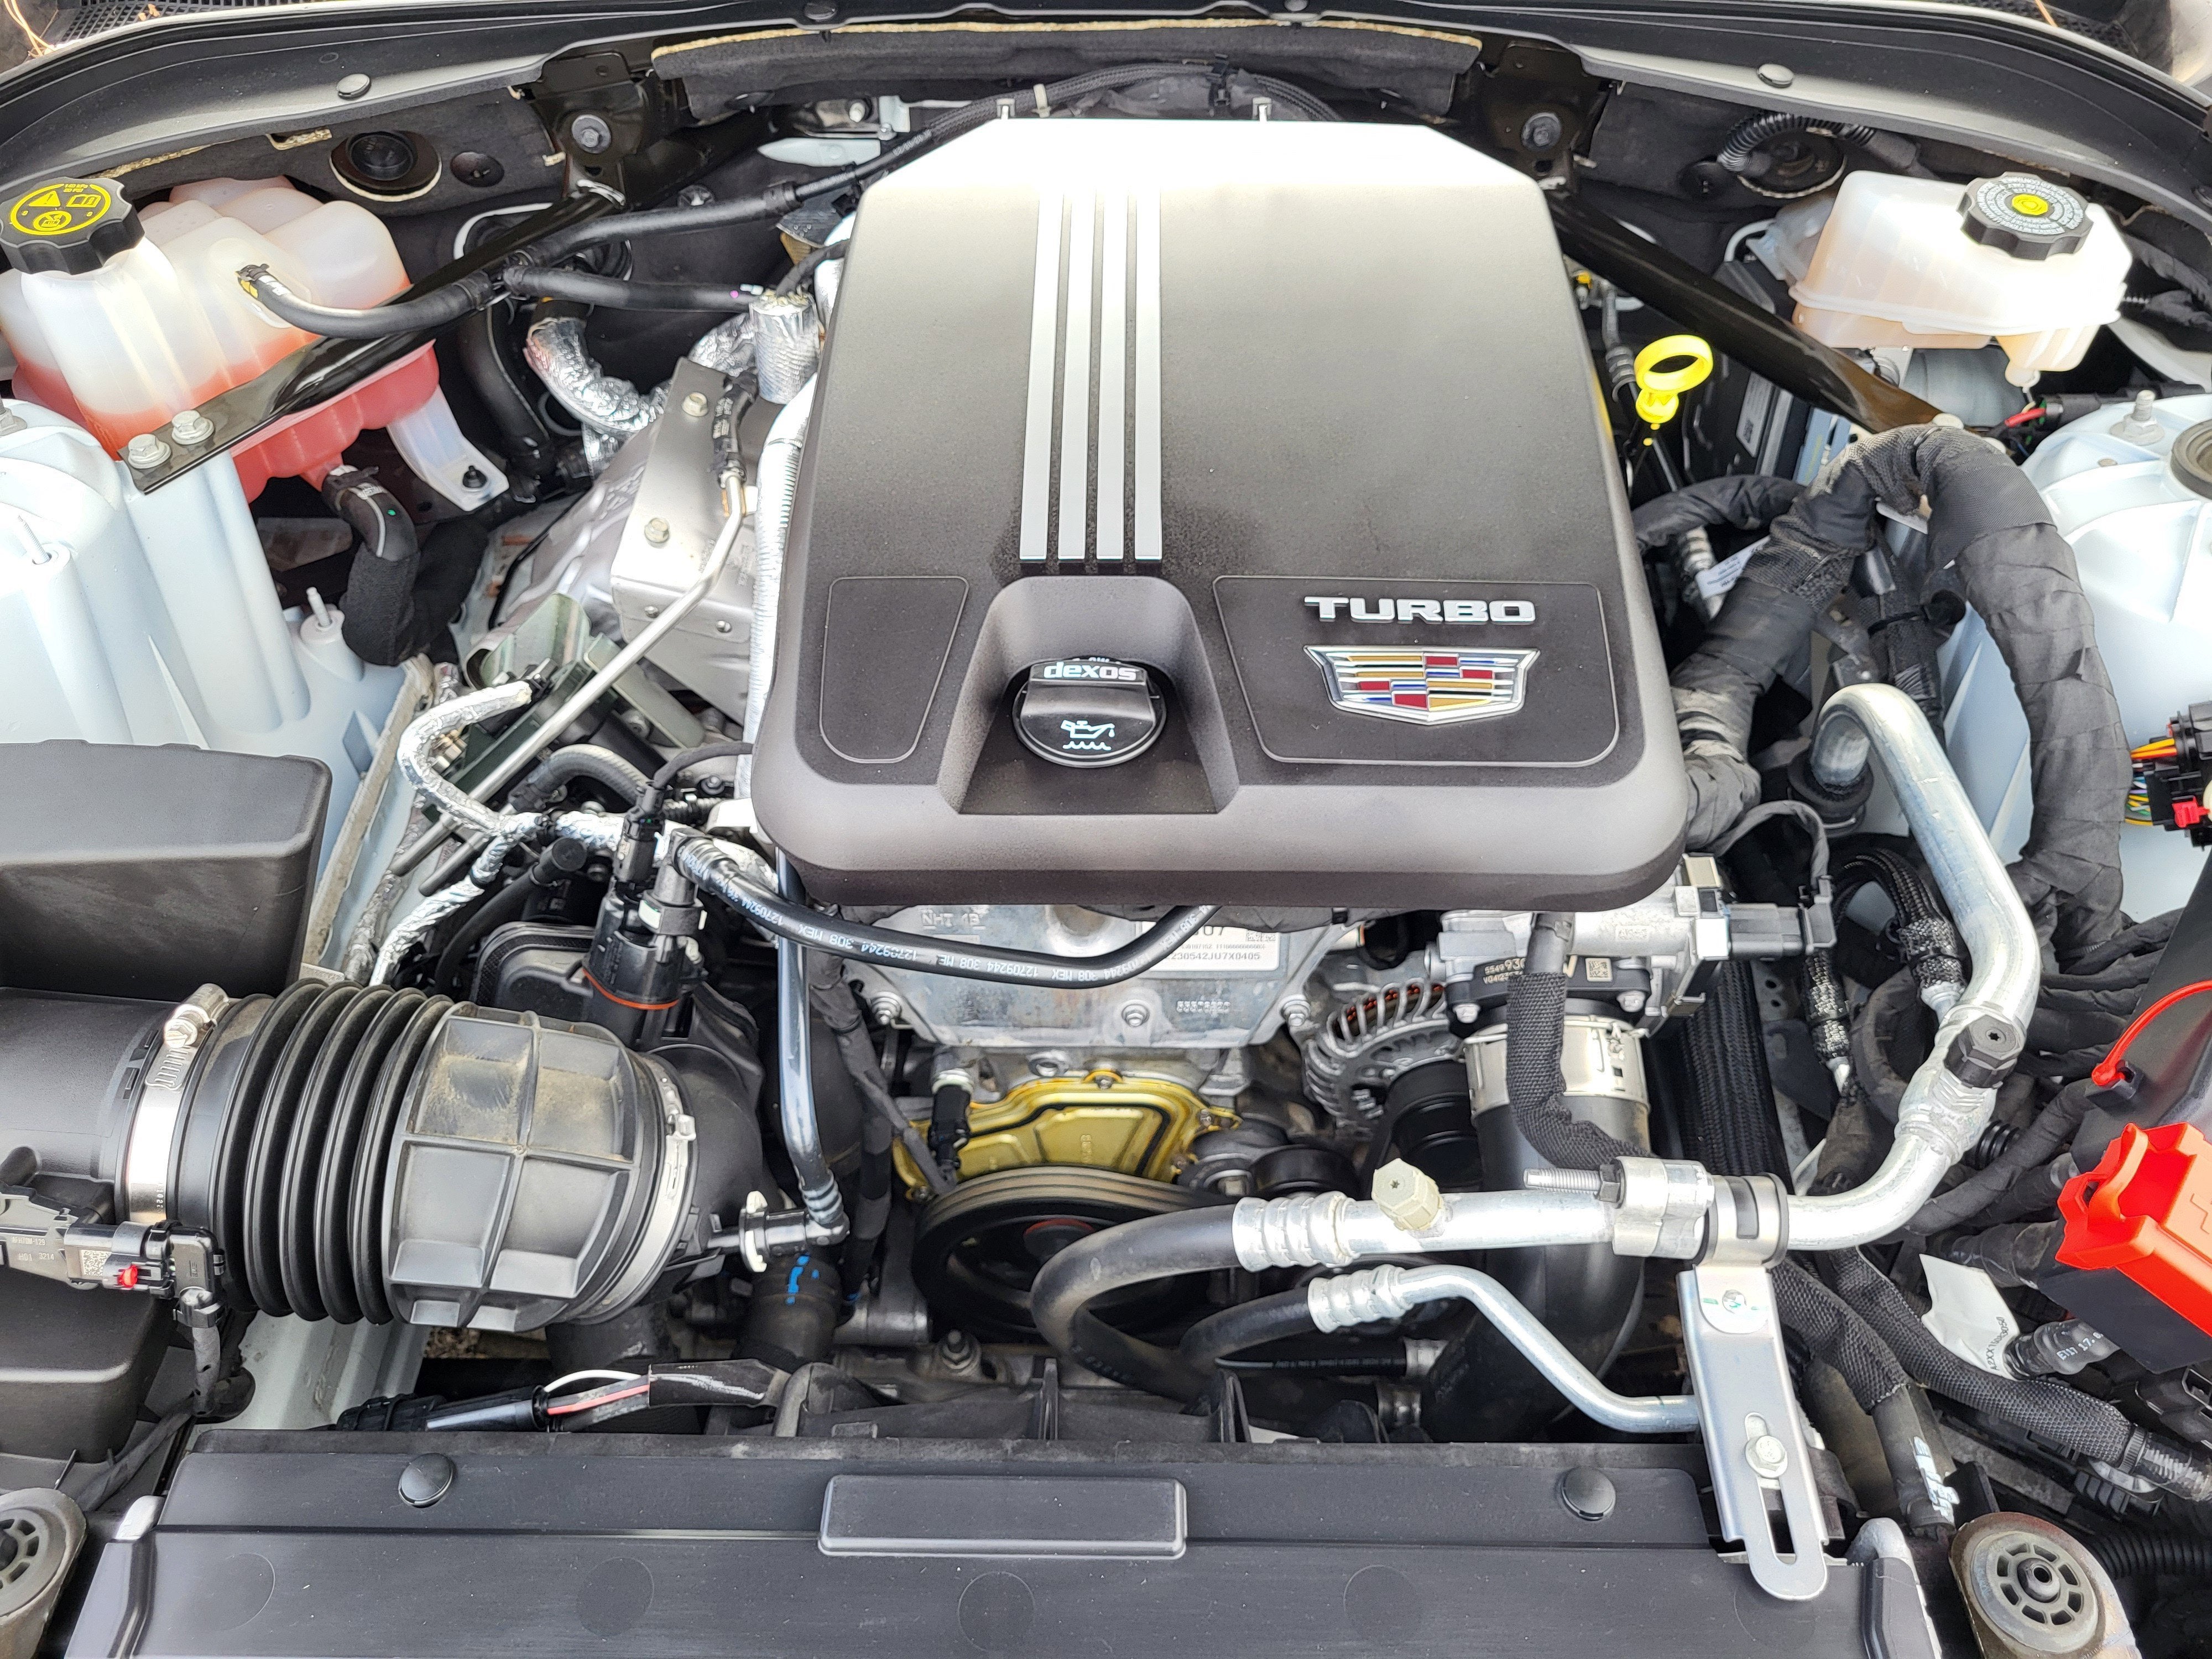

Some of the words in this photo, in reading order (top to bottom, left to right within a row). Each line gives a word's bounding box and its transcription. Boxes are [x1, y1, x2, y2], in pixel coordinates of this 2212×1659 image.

[1304, 596, 1536, 625] TURBO
[1044, 661, 1139, 681] dexos
[798, 924, 824, 940] MEX
[829, 934, 854, 950] 308
[936, 954, 954, 967] ME
[959, 958, 981, 971] 308
[1051, 968, 1073, 982] MEX
[38, 1252, 55, 1261] 3214
